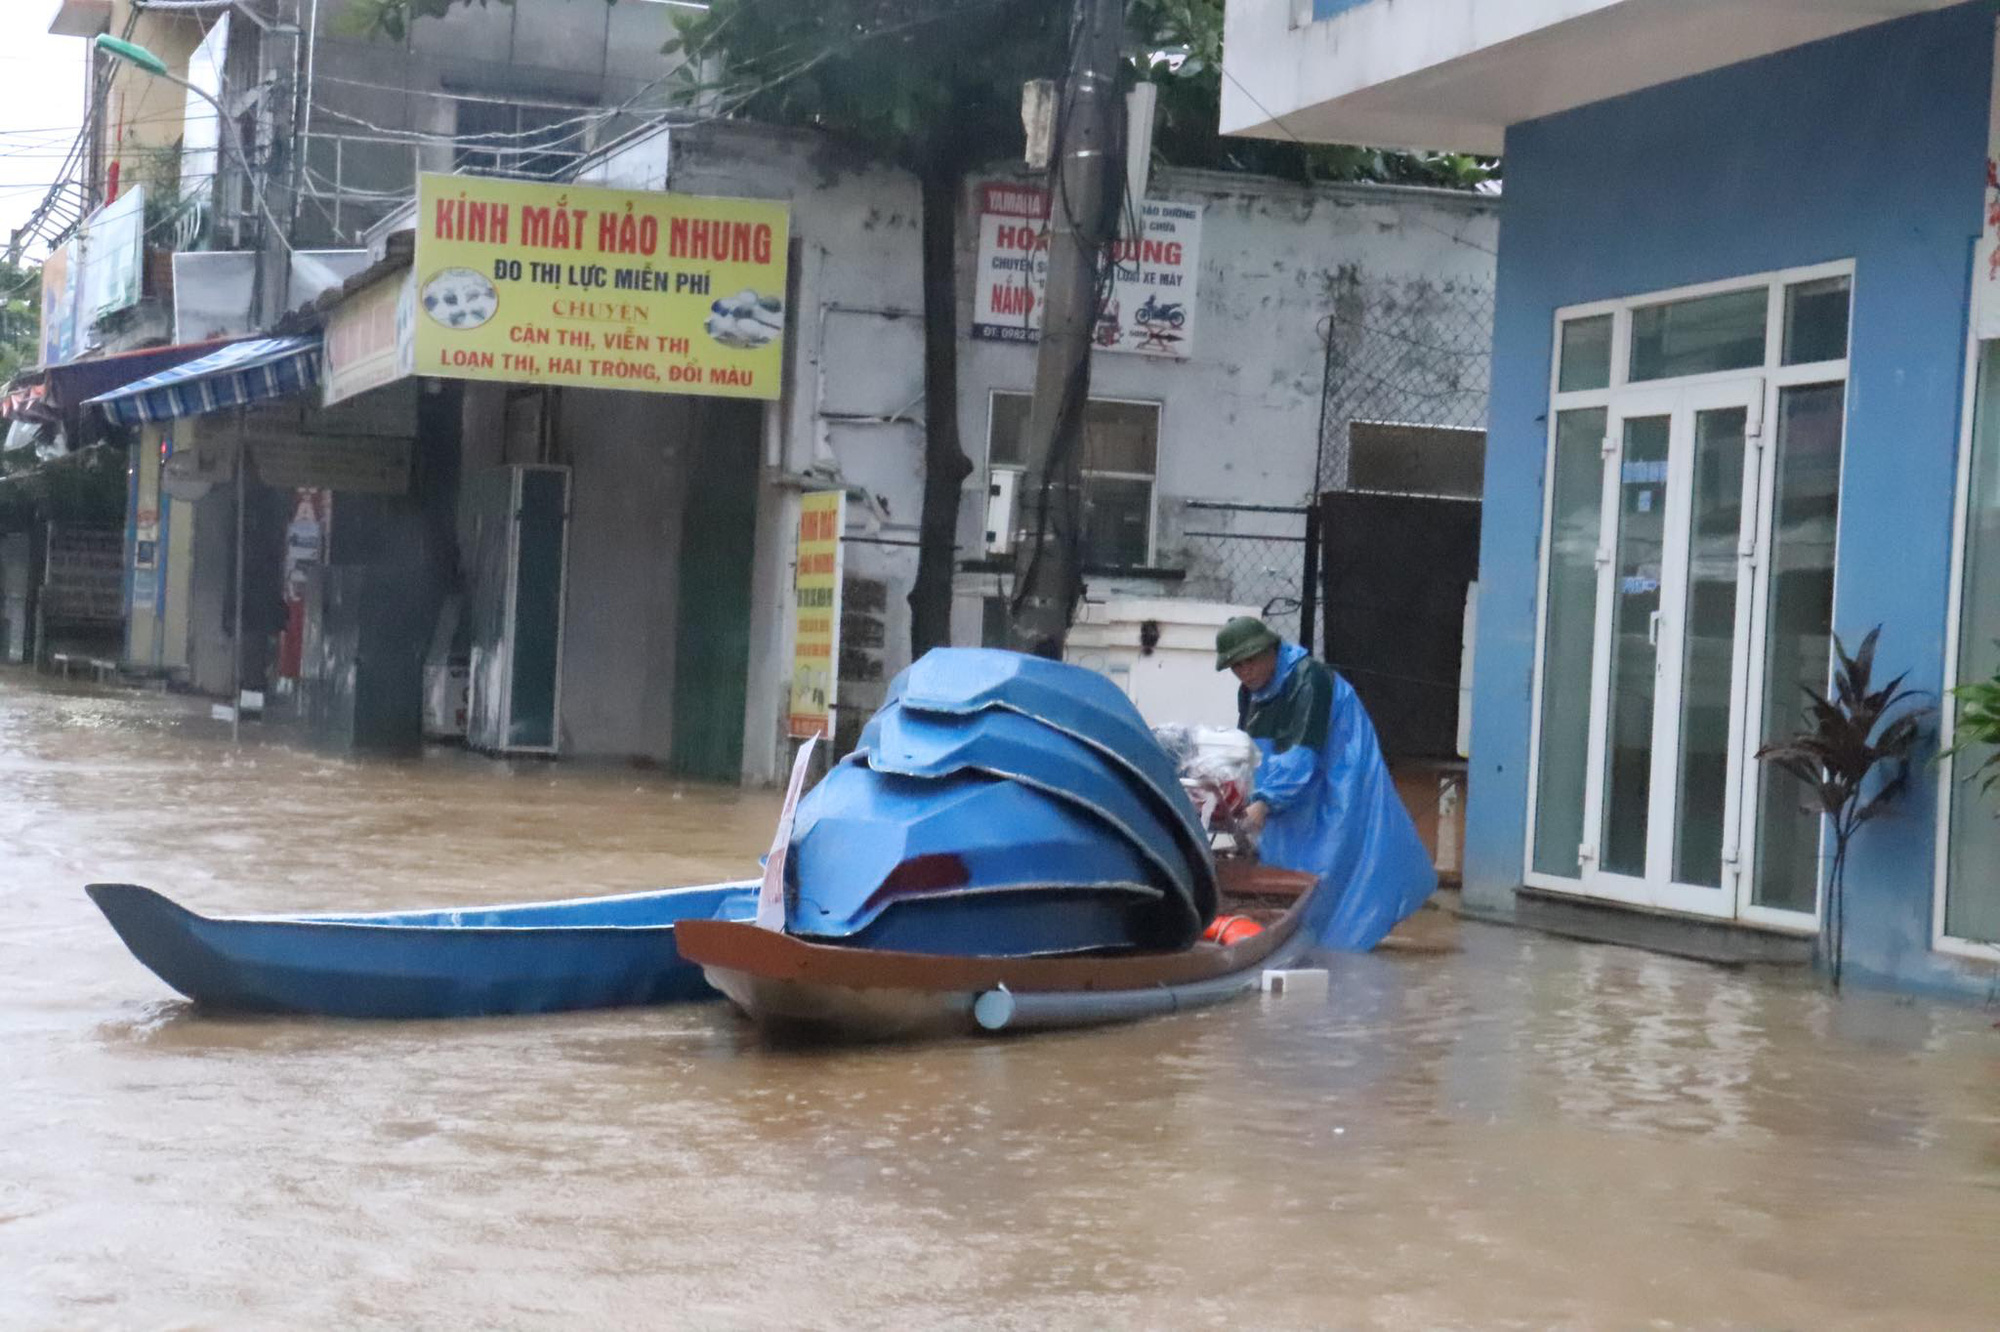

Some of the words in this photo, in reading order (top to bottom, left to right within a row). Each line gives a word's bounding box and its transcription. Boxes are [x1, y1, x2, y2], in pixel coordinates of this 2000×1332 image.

[435, 191, 509, 244] KÍNH
[520, 193, 588, 251] MẮT
[598, 200, 658, 256] HẢO
[669, 216, 772, 264] NHUNG
[494, 259, 521, 280] ĐO
[530, 262, 561, 290] THỊ
[569, 262, 607, 292] LỰC
[614, 262, 668, 293] MIỄN
[675, 270, 712, 295] PHÍ
[1142, 272, 1157, 285] XE
[510, 322, 550, 349] CẬN
[556, 329, 596, 352] THỊ,
[603, 326, 649, 351] VIỄN
[656, 336, 690, 359] THỊ
[440, 348, 494, 372] LOẠN
[501, 353, 541, 376] THỊ,
[548, 356, 582, 376] HAI
[709, 365, 754, 387] MÀU
